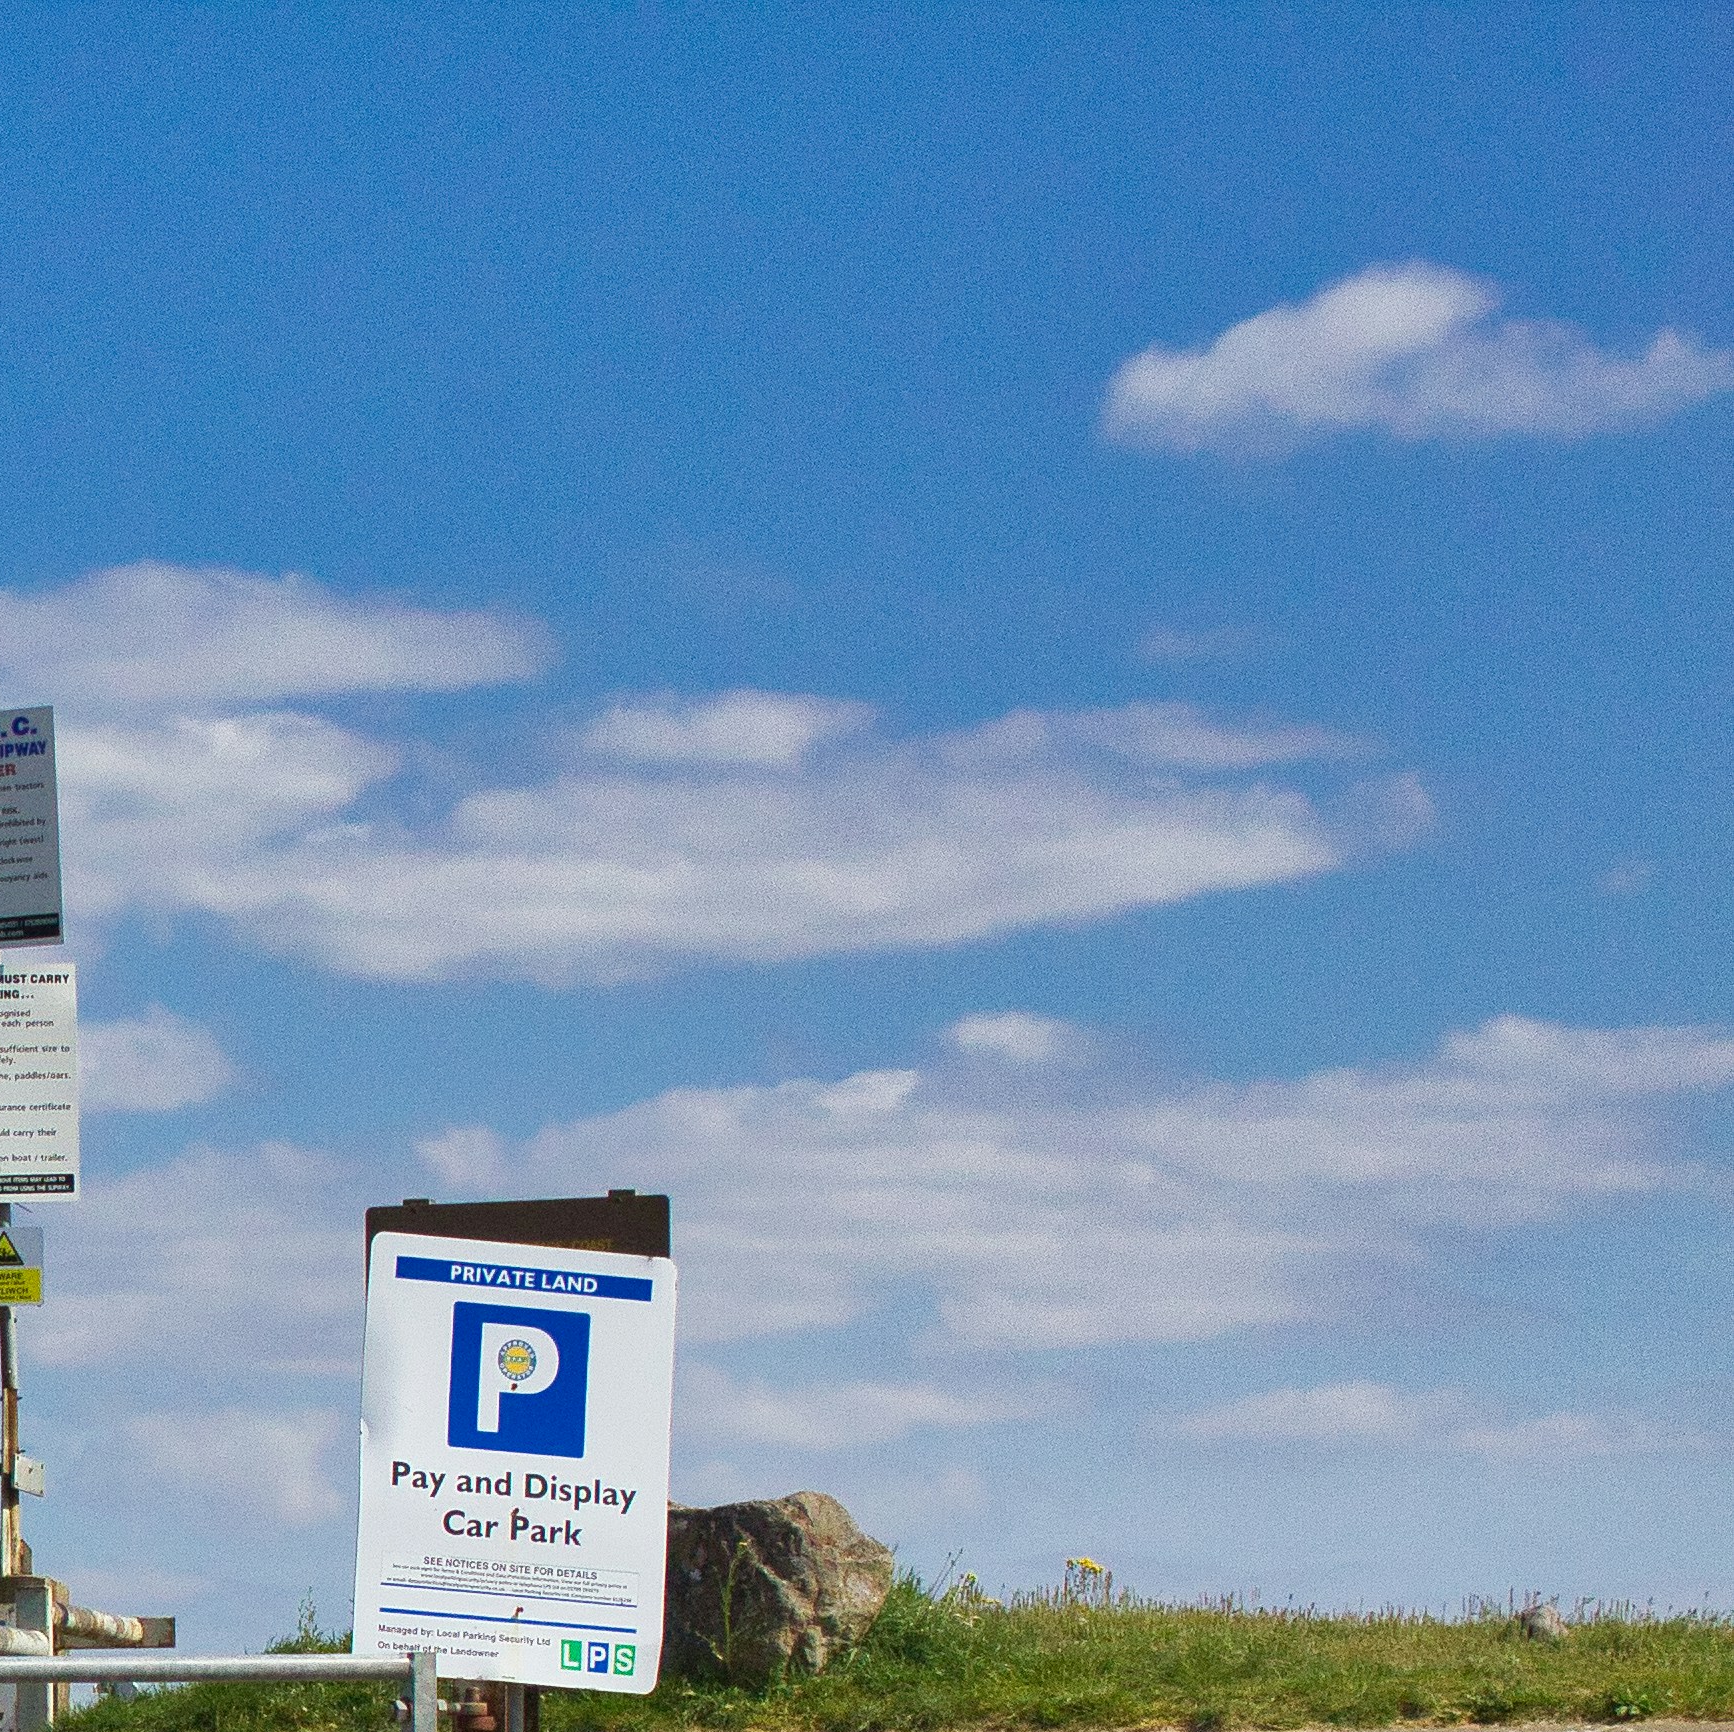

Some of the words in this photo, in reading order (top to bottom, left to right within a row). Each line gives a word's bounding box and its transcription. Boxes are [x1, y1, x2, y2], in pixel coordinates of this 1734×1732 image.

[30, 974, 69, 983] CARRY
[1, 1019, 20, 1027] each
[0, 1045, 38, 1053] sufficient
[15, 1071, 71, 1081] paddles/oars.
[13, 1130, 34, 1138] carry
[12, 1153, 31, 1161] boat
[41, 1153, 68, 1161] trailer.
[451, 1266, 535, 1288] PRIVATE
[542, 1273, 598, 1293] LAND
[477, 1322, 559, 1433] P
[391, 1461, 445, 1498] Pay
[457, 1471, 512, 1496] and
[524, 1473, 637, 1514] Display
[443, 1509, 498, 1538] Car
[510, 1514, 582, 1546] Park
[423, 1556, 442, 1566] SEE
[446, 1559, 488, 1570] NOTICES
[492, 1563, 507, 1572] ON
[509, 1564, 531, 1574] SITE
[534, 1566, 553, 1576] FOR
[557, 1569, 597, 1580] DETAILS
[378, 1624, 418, 1636] Managed
[437, 1629, 460, 1638] Local
[463, 1631, 496, 1643] Parking
[499, 1634, 534, 1646] Security
[537, 1638, 550, 1646] Ltd
[377, 1641, 390, 1649] On
[393, 1642, 421, 1651] behalf
[423, 1646, 432, 1654] of
[434, 1646, 447, 1655] the
[451, 1647, 499, 1658] Landowner
